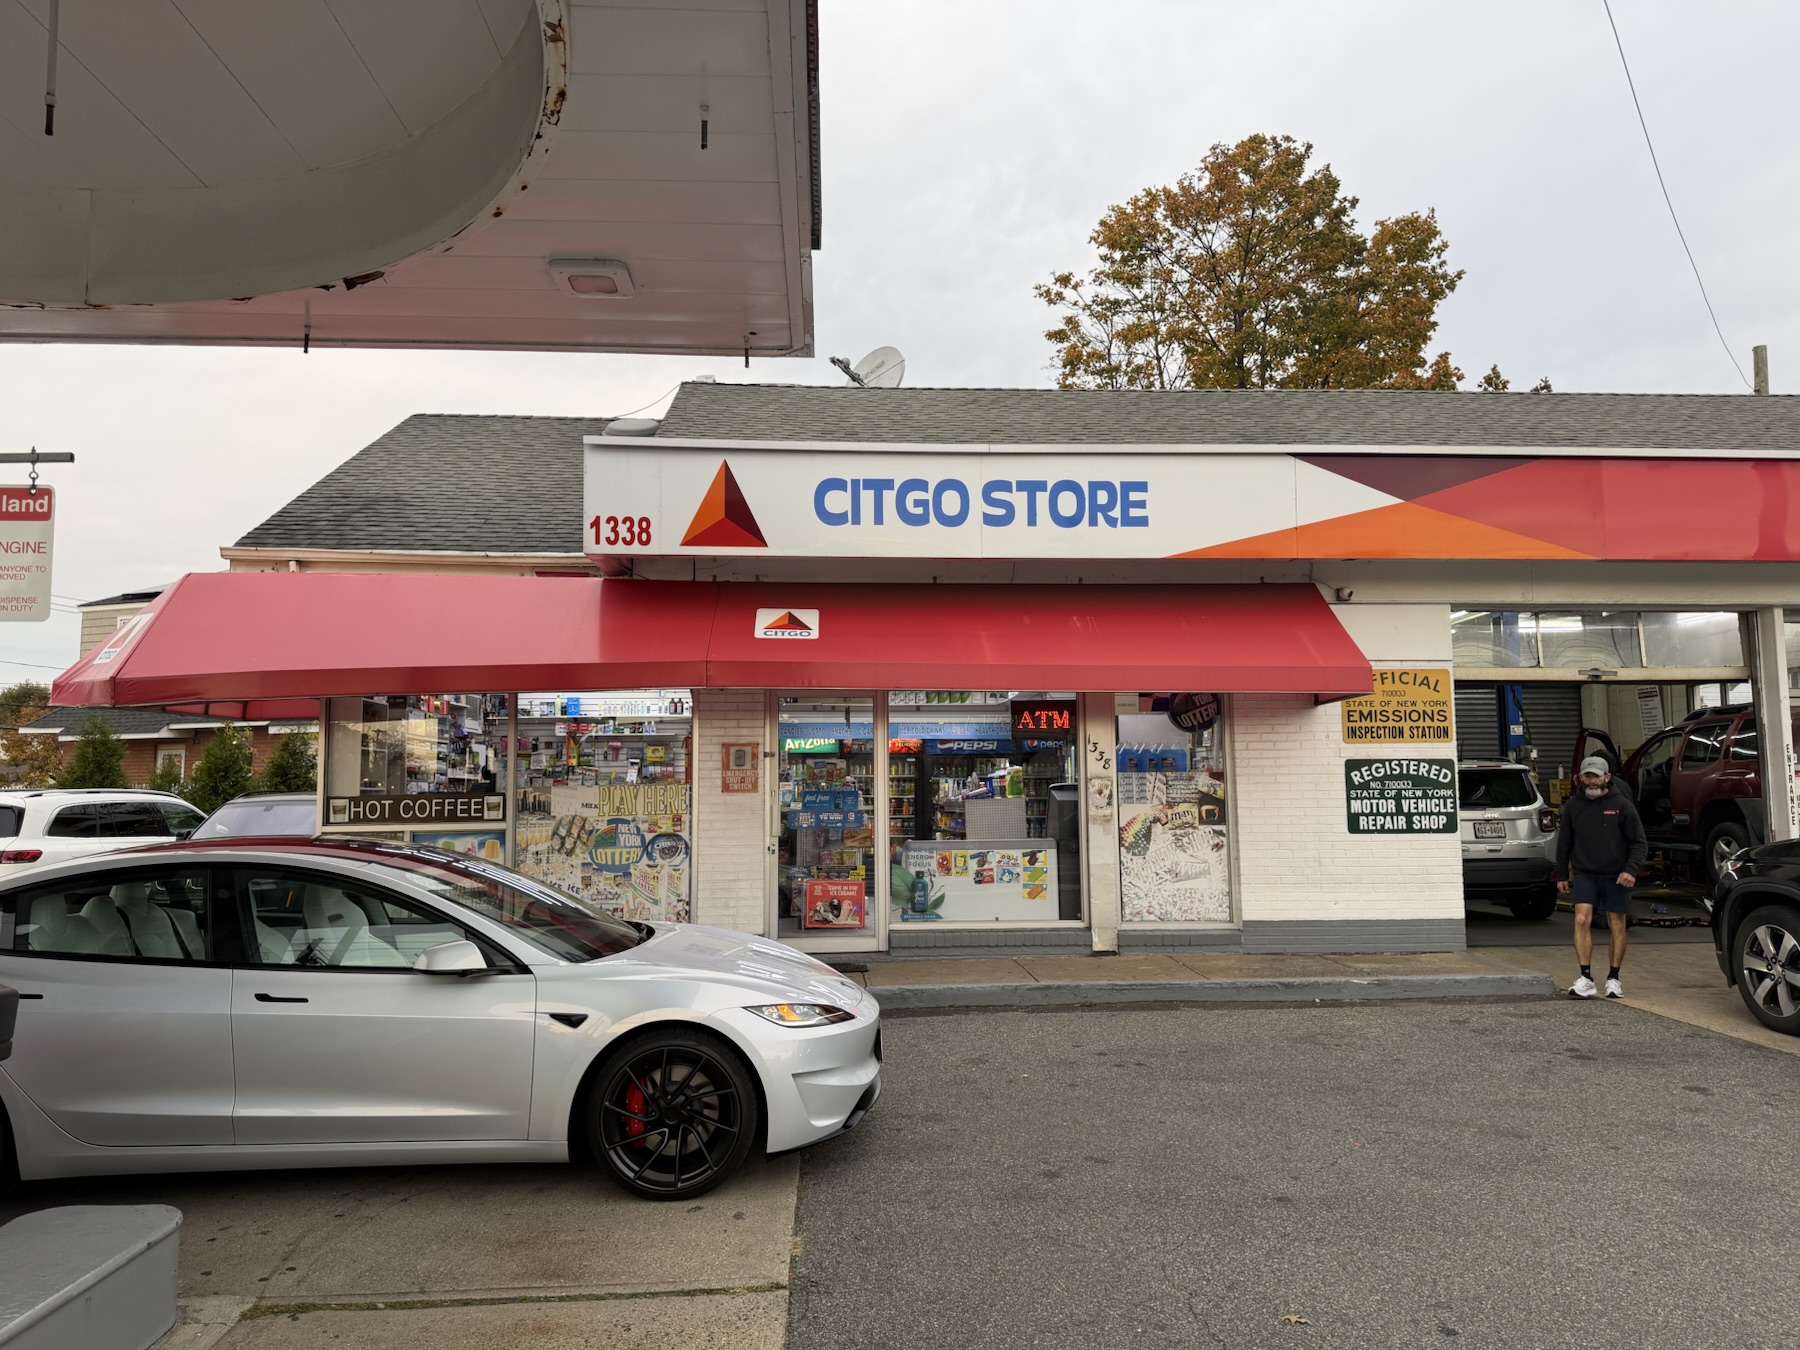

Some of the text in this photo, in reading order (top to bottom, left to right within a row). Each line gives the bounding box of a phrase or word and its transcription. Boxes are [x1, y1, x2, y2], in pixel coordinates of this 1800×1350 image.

[813, 477, 1150, 529] CITGO STORE
[589, 514, 652, 547] 1338
[35, 565, 47, 573] TO
[10, 604, 34, 612] DUTY
[1345, 700, 1449, 708] STATE OF NEW YORK
[1017, 709, 1071, 730] ATM
[1176, 702, 1218, 728] LOTTERY
[1346, 709, 1448, 724] EMISSIONS
[1346, 725, 1449, 740] INSPECTION STATION
[952, 740, 998, 750] PEPSI
[1350, 759, 1452, 786] REGISTERED
[1785, 743, 1797, 826] ENTRANCE
[598, 783, 688, 816] PLAY HERE
[1350, 789, 1454, 798] STATE OF NEW YORK
[350, 798, 483, 819] HOT COFFEE
[1350, 798, 1455, 814] MOTOR VEHICLE
[617, 823, 637, 834] NEW
[1359, 815, 1448, 830] REPAIR SHOP
[619, 833, 642, 847] YORK
[591, 848, 643, 865] LOTTERY
[567, 883, 581, 895] ICE
